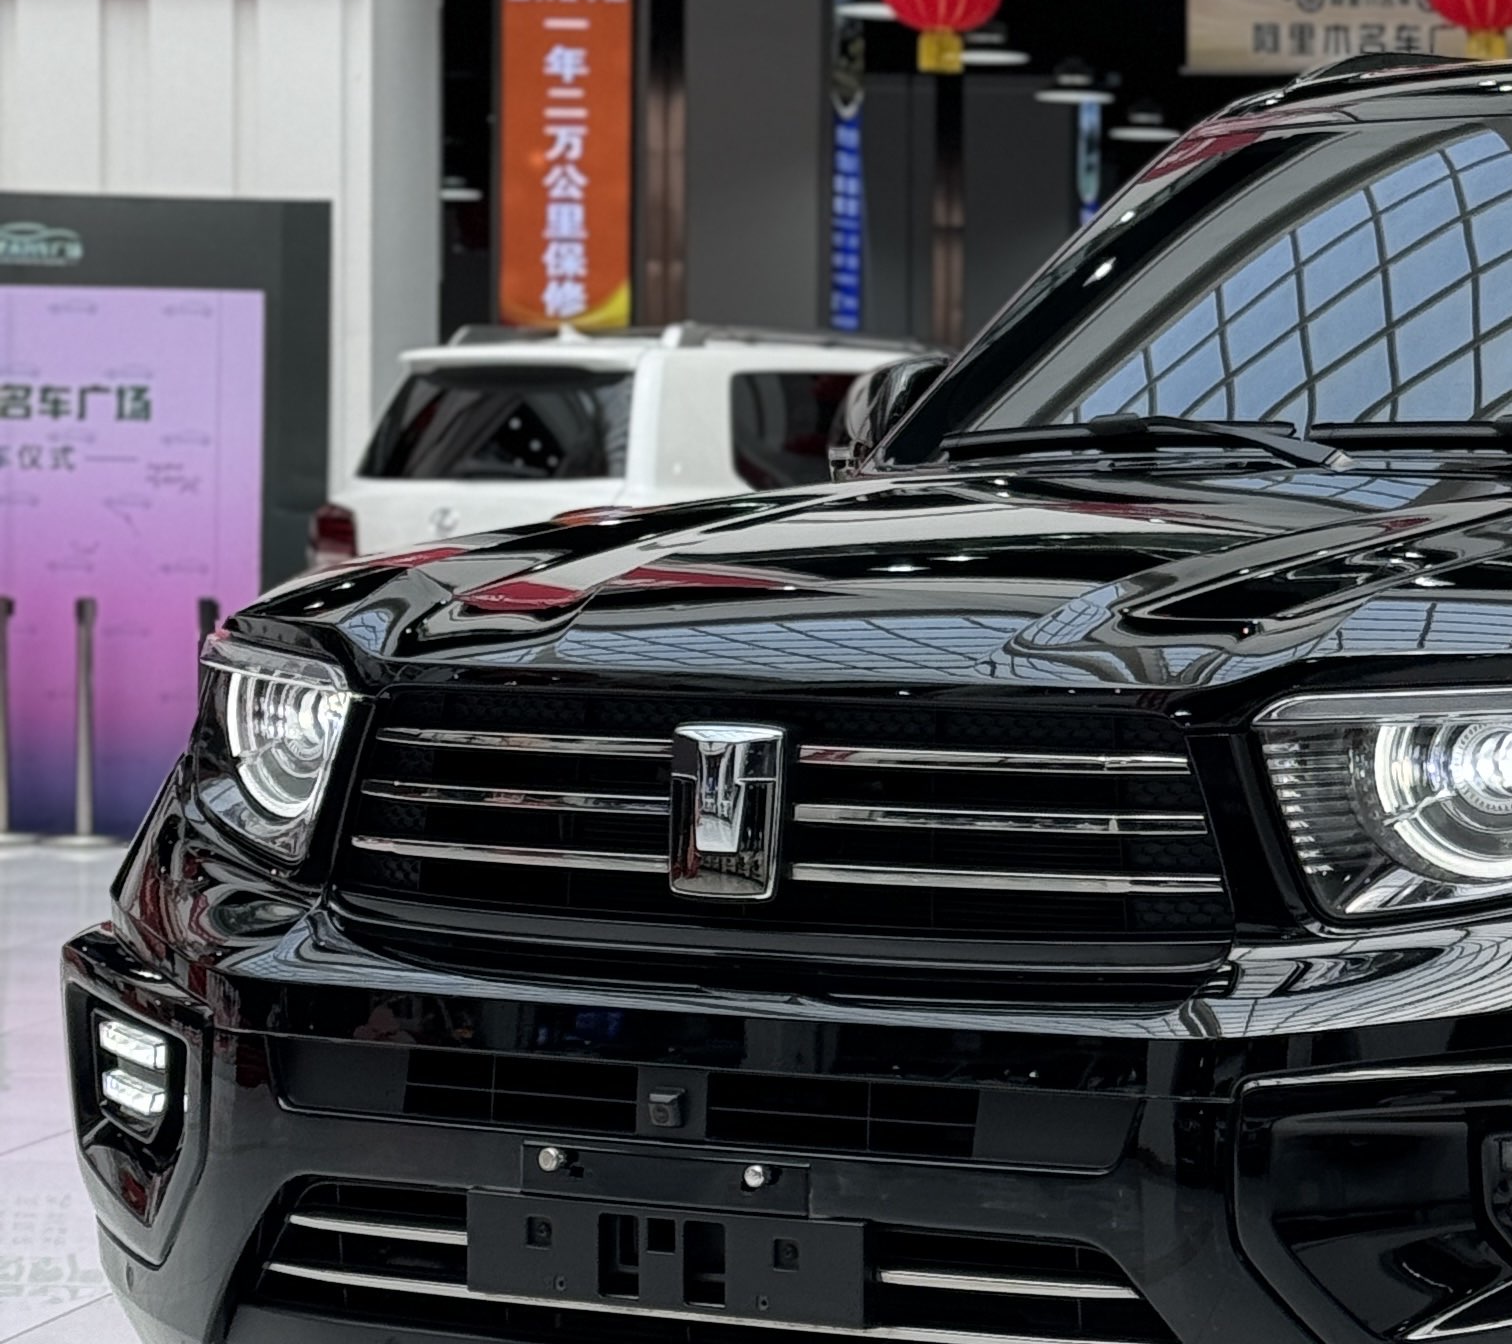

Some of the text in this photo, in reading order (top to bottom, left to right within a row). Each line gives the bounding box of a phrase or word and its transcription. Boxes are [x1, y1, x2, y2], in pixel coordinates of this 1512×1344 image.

[541, 17, 591, 318] 一年二万公里保修
